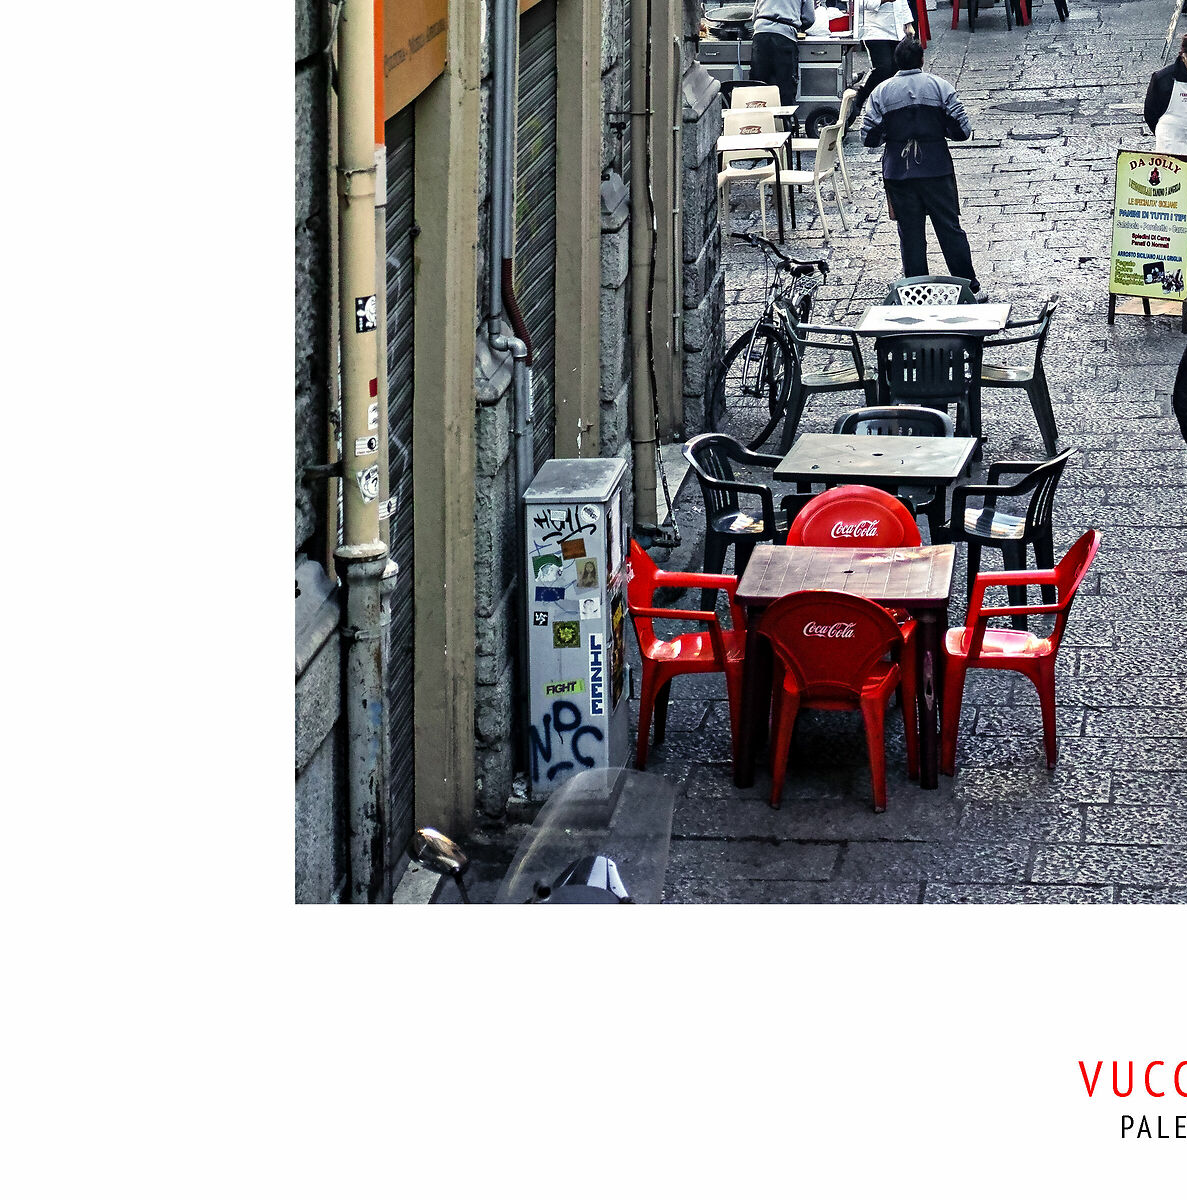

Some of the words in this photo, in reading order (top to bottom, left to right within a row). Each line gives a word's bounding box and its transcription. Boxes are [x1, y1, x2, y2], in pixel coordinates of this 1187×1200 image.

[1129, 158, 1145, 170] DA
[1148, 157, 1181, 174] JOLLY
[1119, 208, 1140, 219] PANINI
[1142, 211, 1149, 219] DI
[1150, 211, 1169, 221] TUTTI
[1174, 213, 1187, 222] TIPI
[1131, 233, 1150, 241] Spiedini
[1117, 250, 1136, 258] ARROSTO
[1136, 252, 1156, 260] SICILIANO
[831, 520, 880, 538] Coca-Cola
[803, 621, 857, 638] Coca-Cola
[590, 635, 603, 715] LIZEE
[546, 681, 577, 695] FIGHT
